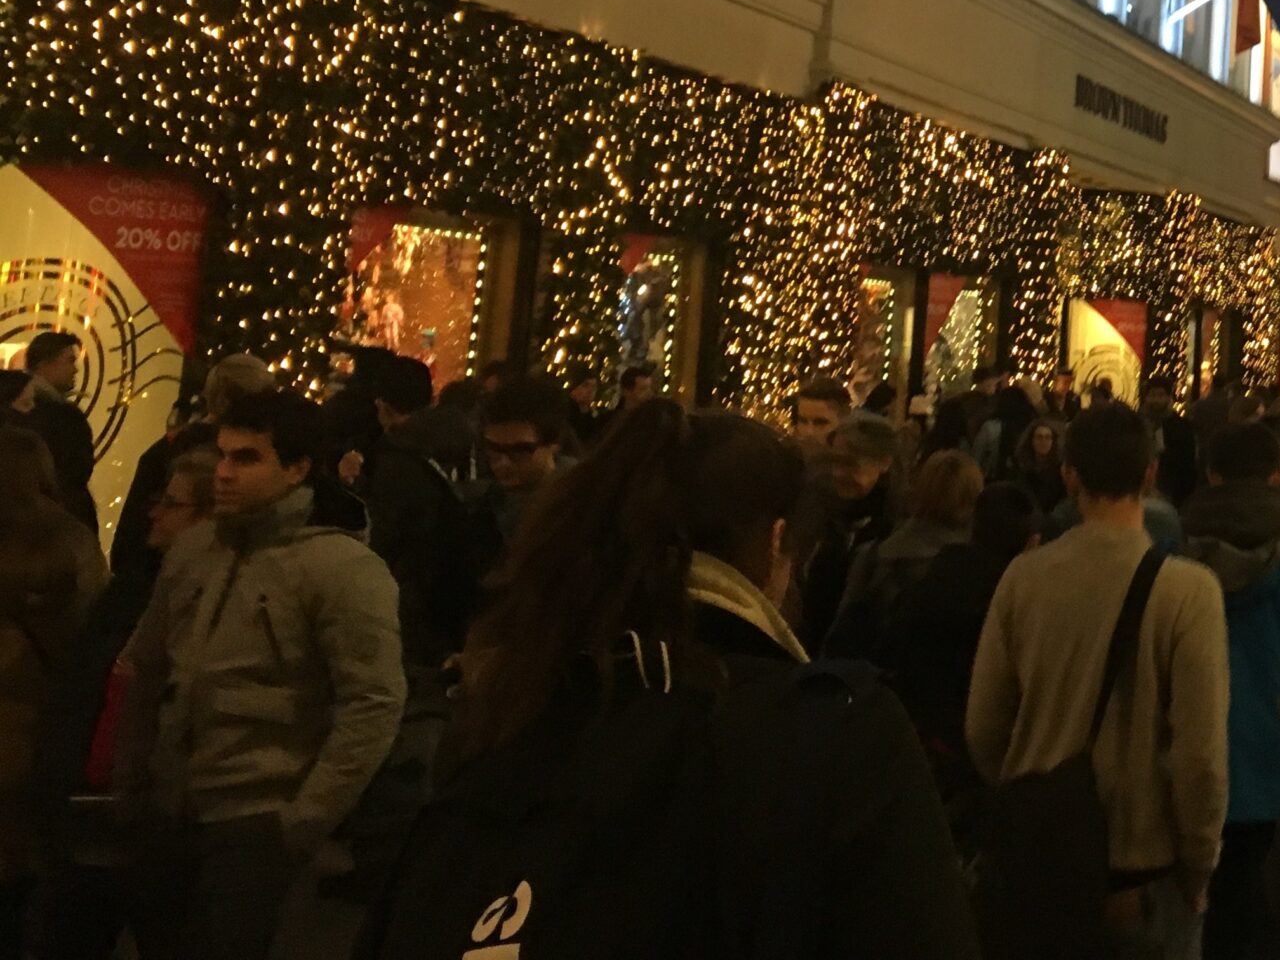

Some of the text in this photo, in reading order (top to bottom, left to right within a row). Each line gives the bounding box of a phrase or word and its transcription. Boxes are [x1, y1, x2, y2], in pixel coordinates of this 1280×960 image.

[88, 195, 206, 223] COMES EARLY
[114, 225, 203, 252] 20% OFF
